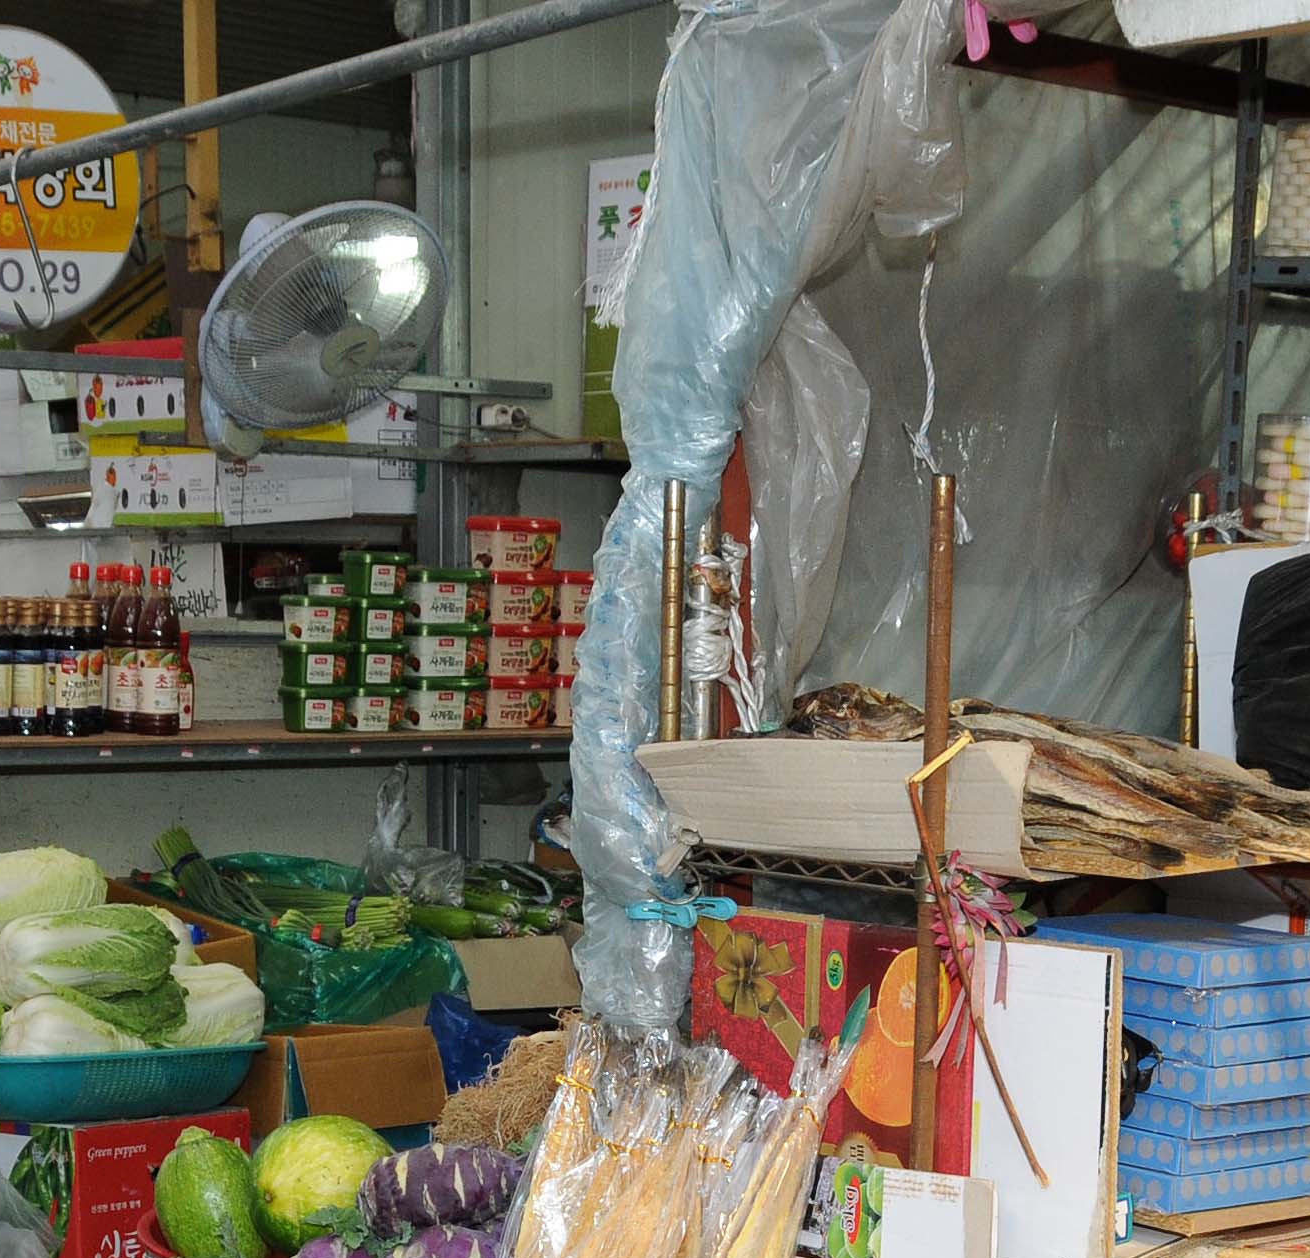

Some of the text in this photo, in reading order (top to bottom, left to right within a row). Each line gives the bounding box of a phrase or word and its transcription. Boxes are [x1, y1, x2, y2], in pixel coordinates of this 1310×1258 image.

[87, 1143, 148, 1163] Green peppers
[840, 1184, 860, 1234] 5kg
